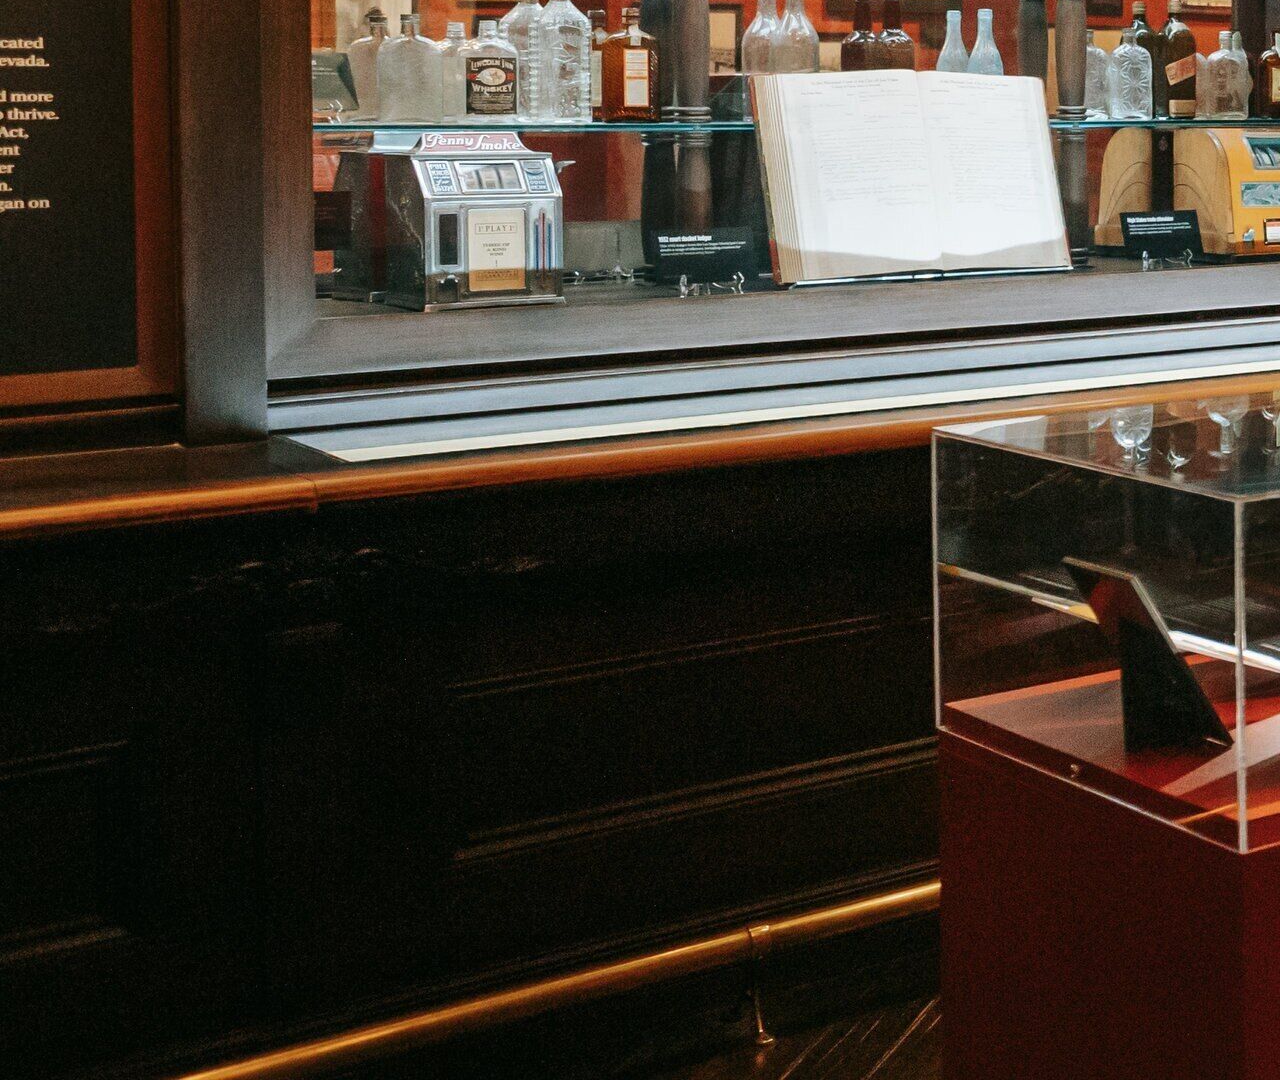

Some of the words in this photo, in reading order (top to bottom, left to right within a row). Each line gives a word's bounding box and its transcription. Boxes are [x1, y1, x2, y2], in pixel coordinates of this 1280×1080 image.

[471, 82, 514, 92] WHISKEY
[10, 92, 54, 103] more
[7, 108, 60, 120] thrive.
[0, 126, 29, 139] Act,
[426, 133, 473, 148] Penny
[468, 134, 522, 151] Smoke
[28, 199, 50, 209] on
